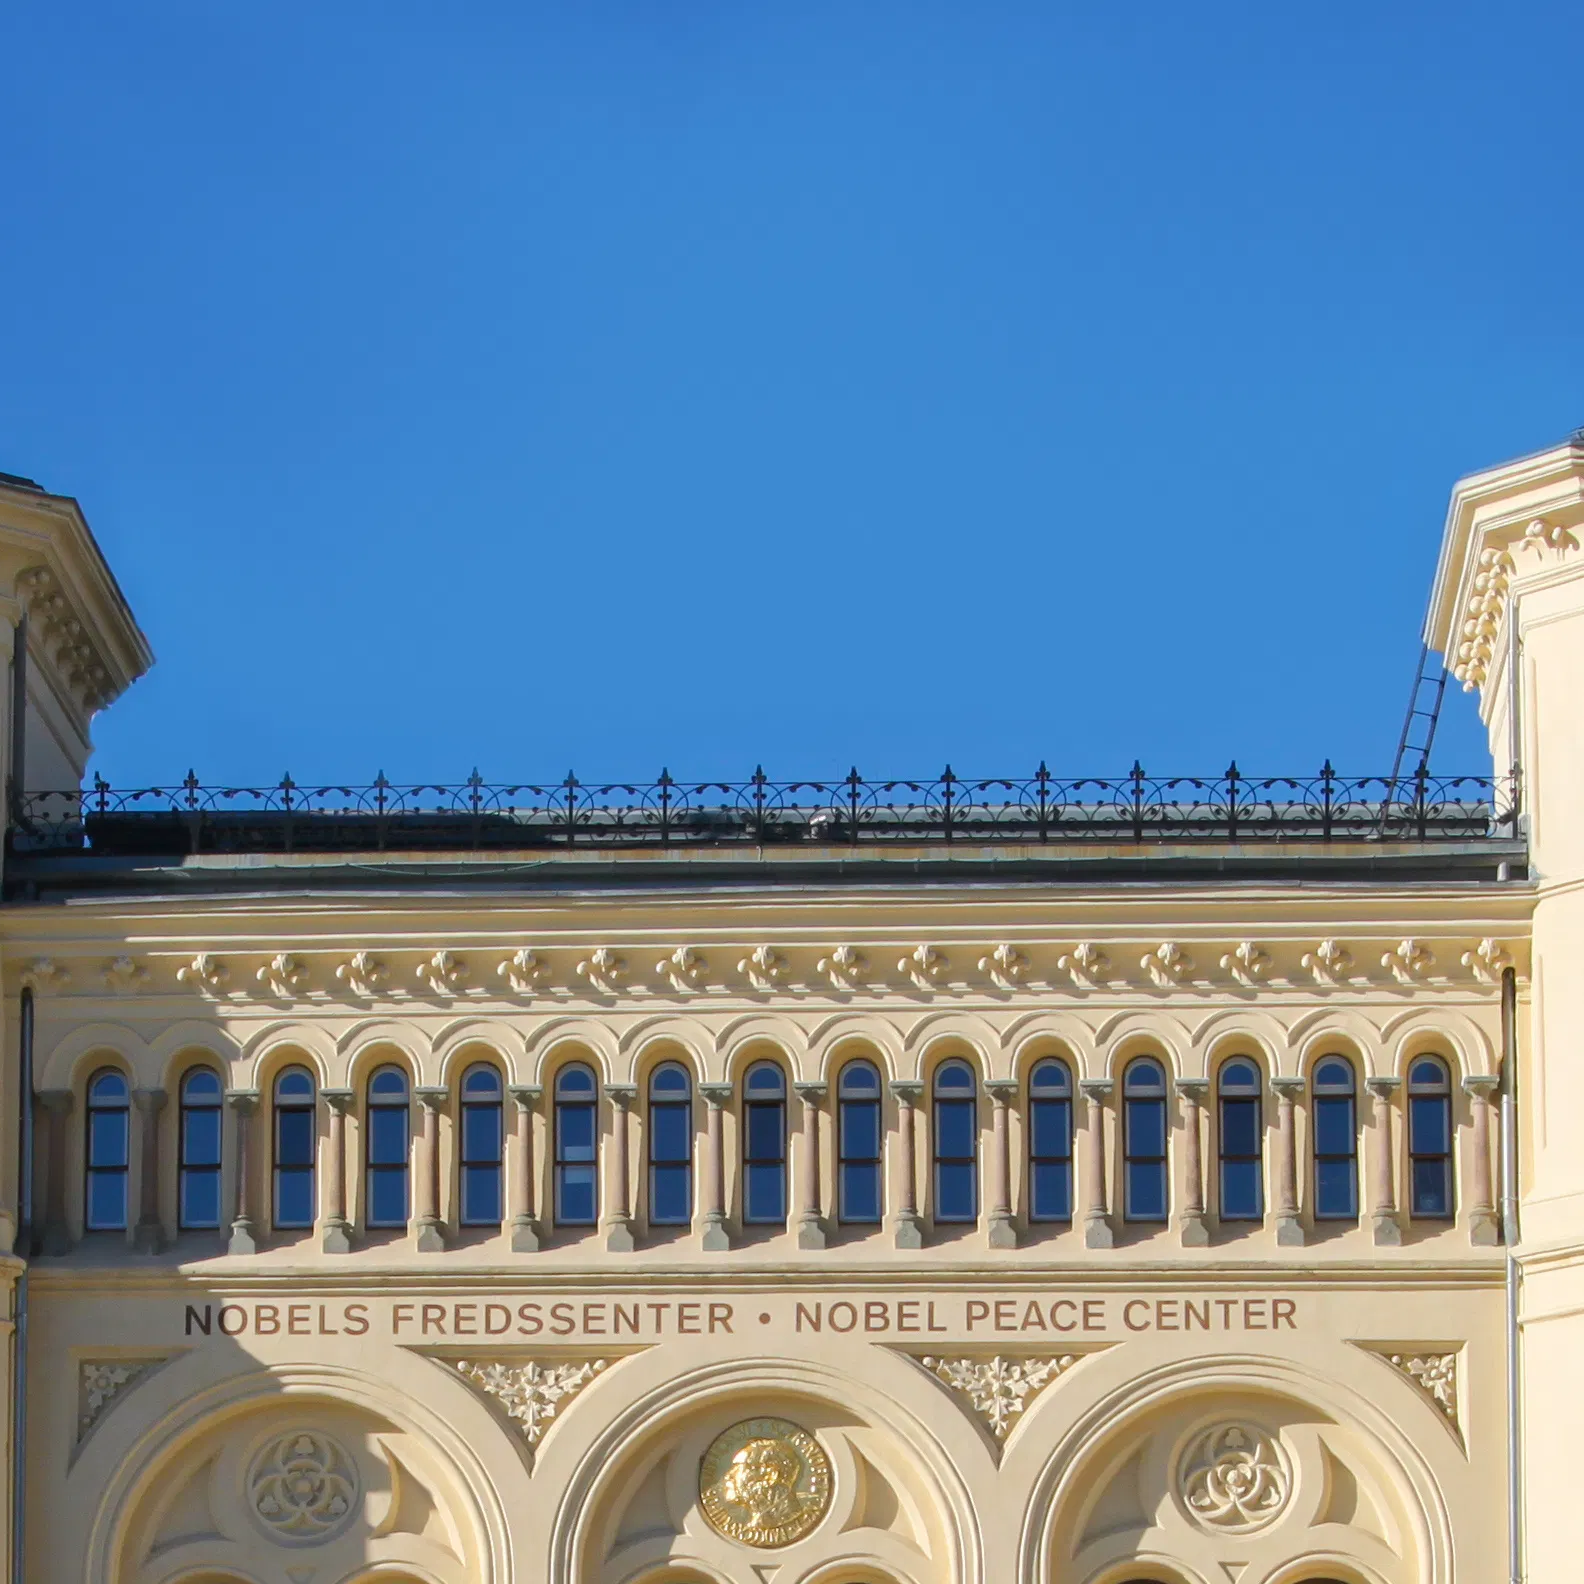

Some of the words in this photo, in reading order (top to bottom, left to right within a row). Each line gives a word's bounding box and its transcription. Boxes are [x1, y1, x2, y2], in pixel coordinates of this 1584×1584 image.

[182, 1303, 373, 1338] NOBELS
[391, 1300, 735, 1337] FREDSSENTER
[793, 1300, 950, 1334] NOBEL
[965, 1299, 1108, 1333] PEACE
[1122, 1297, 1299, 1332] CENTER
